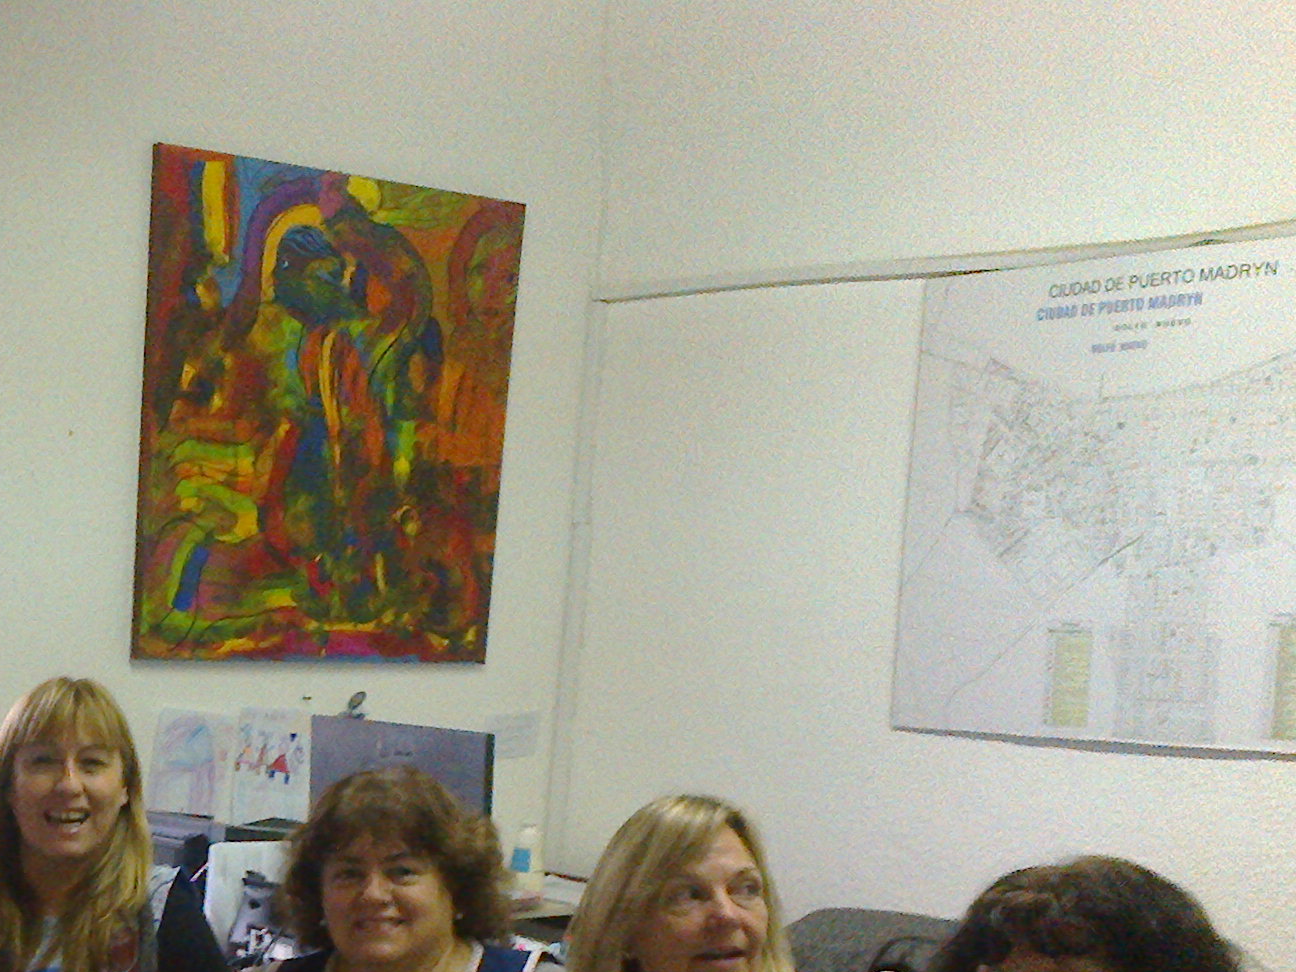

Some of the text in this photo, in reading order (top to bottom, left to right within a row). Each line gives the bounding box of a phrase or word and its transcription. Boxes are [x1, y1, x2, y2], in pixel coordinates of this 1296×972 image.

[1049, 260, 1278, 299] CIUDAD DE PUERTO MADRYN
[1081, 301, 1096, 317] DE
